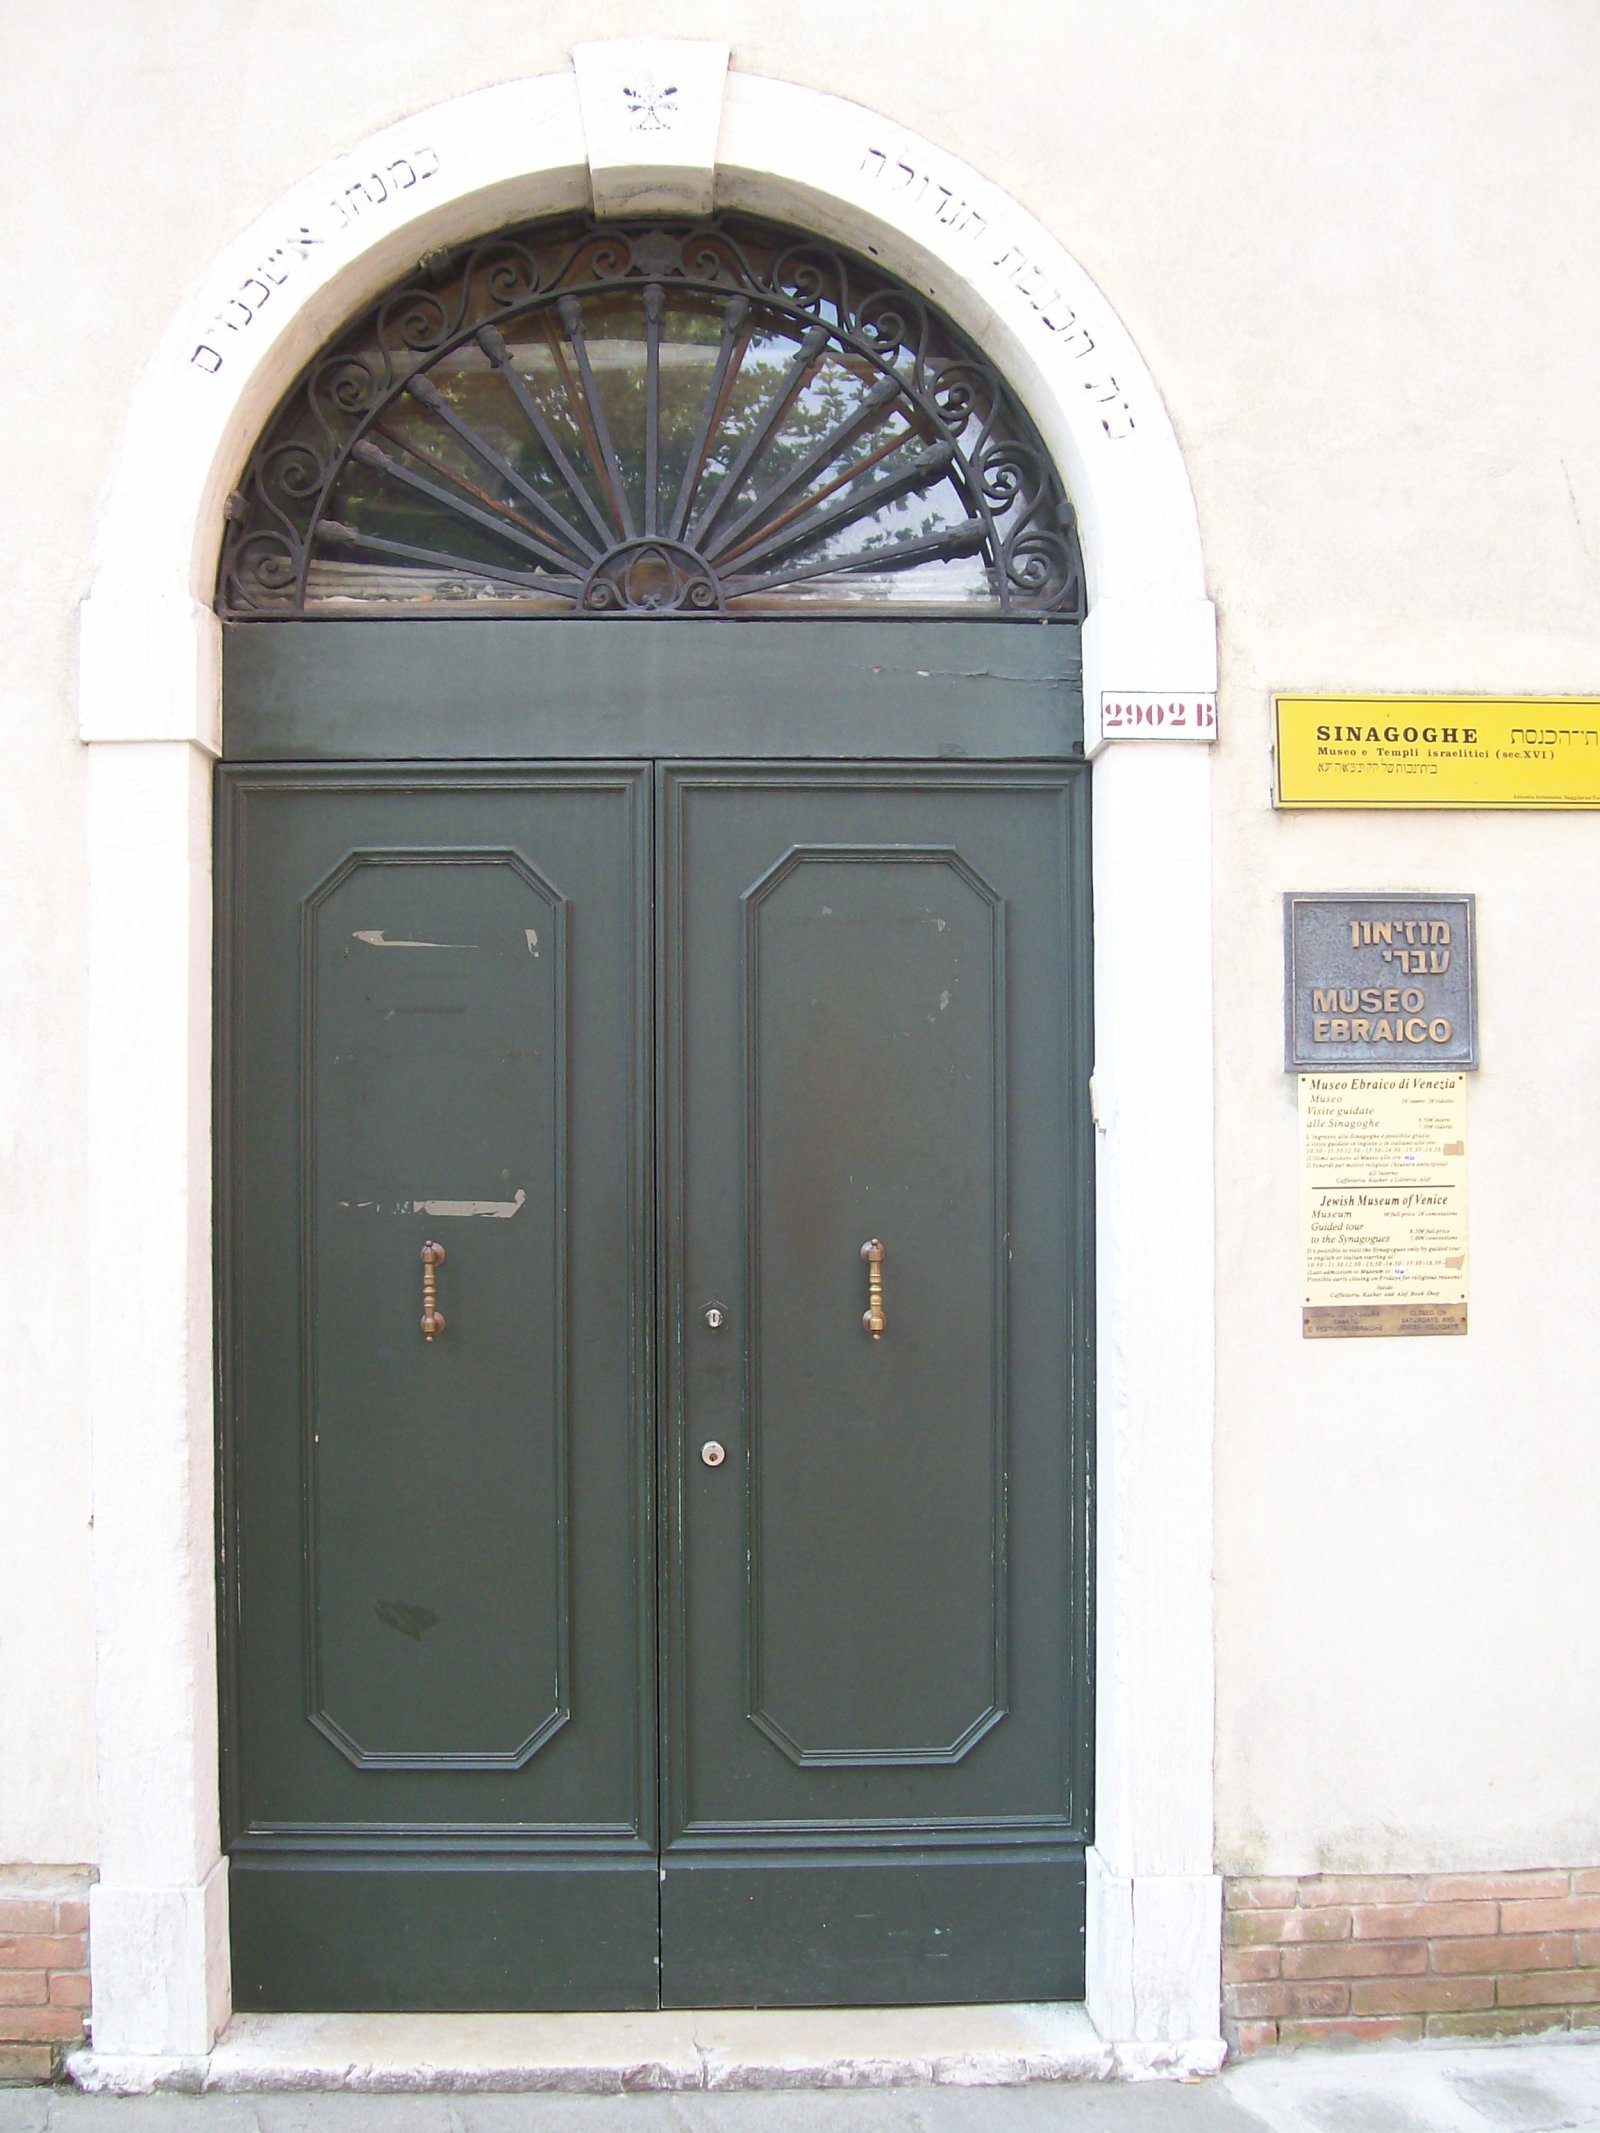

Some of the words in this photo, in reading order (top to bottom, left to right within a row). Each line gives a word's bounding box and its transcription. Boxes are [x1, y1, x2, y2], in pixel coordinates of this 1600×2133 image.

[993, 245, 1096, 359] הכנסת
[1083, 376, 1135, 440] בית
[1104, 702, 1186, 727] 2902
[1196, 703, 1214, 727] B
[1316, 725, 1478, 744] SINAGOGHE
[1317, 746, 1357, 757] Museo
[1361, 748, 1368, 756] e
[1376, 747, 1419, 759] Templi
[1427, 748, 1489, 758] israelitici
[1349, 920, 1451, 948] מוזיאון
[1382, 949, 1451, 974] עברי
[1312, 987, 1426, 1014] MUSEO
[1313, 1016, 1454, 1044] EBRAICO
[1309, 1079, 1348, 1090] Museo
[1351, 1078, 1396, 1090] Ebraico
[1399, 1078, 1410, 1089] di
[1413, 1077, 1456, 1090] Venezia
[1310, 1095, 1343, 1103] Museo
[1307, 1106, 1335, 1116] Visite
[1337, 1106, 1375, 1117] guidate
[1306, 1119, 1326, 1128] alle
[1328, 1118, 1380, 1130] Sinagoghe
[1320, 1195, 1355, 1207] Jewish
[1357, 1194, 1400, 1207] Museum
[1402, 1194, 1414, 1209] of
[1416, 1194, 1449, 1205] Venice
[1311, 1210, 1352, 1219] Museum
[1310, 1221, 1344, 1231] Guided
[1346, 1223, 1365, 1231] tour
[1311, 1236, 1320, 1244] to
[1322, 1234, 1336, 1244] the
[1338, 1233, 1391, 1246] Synagogues
